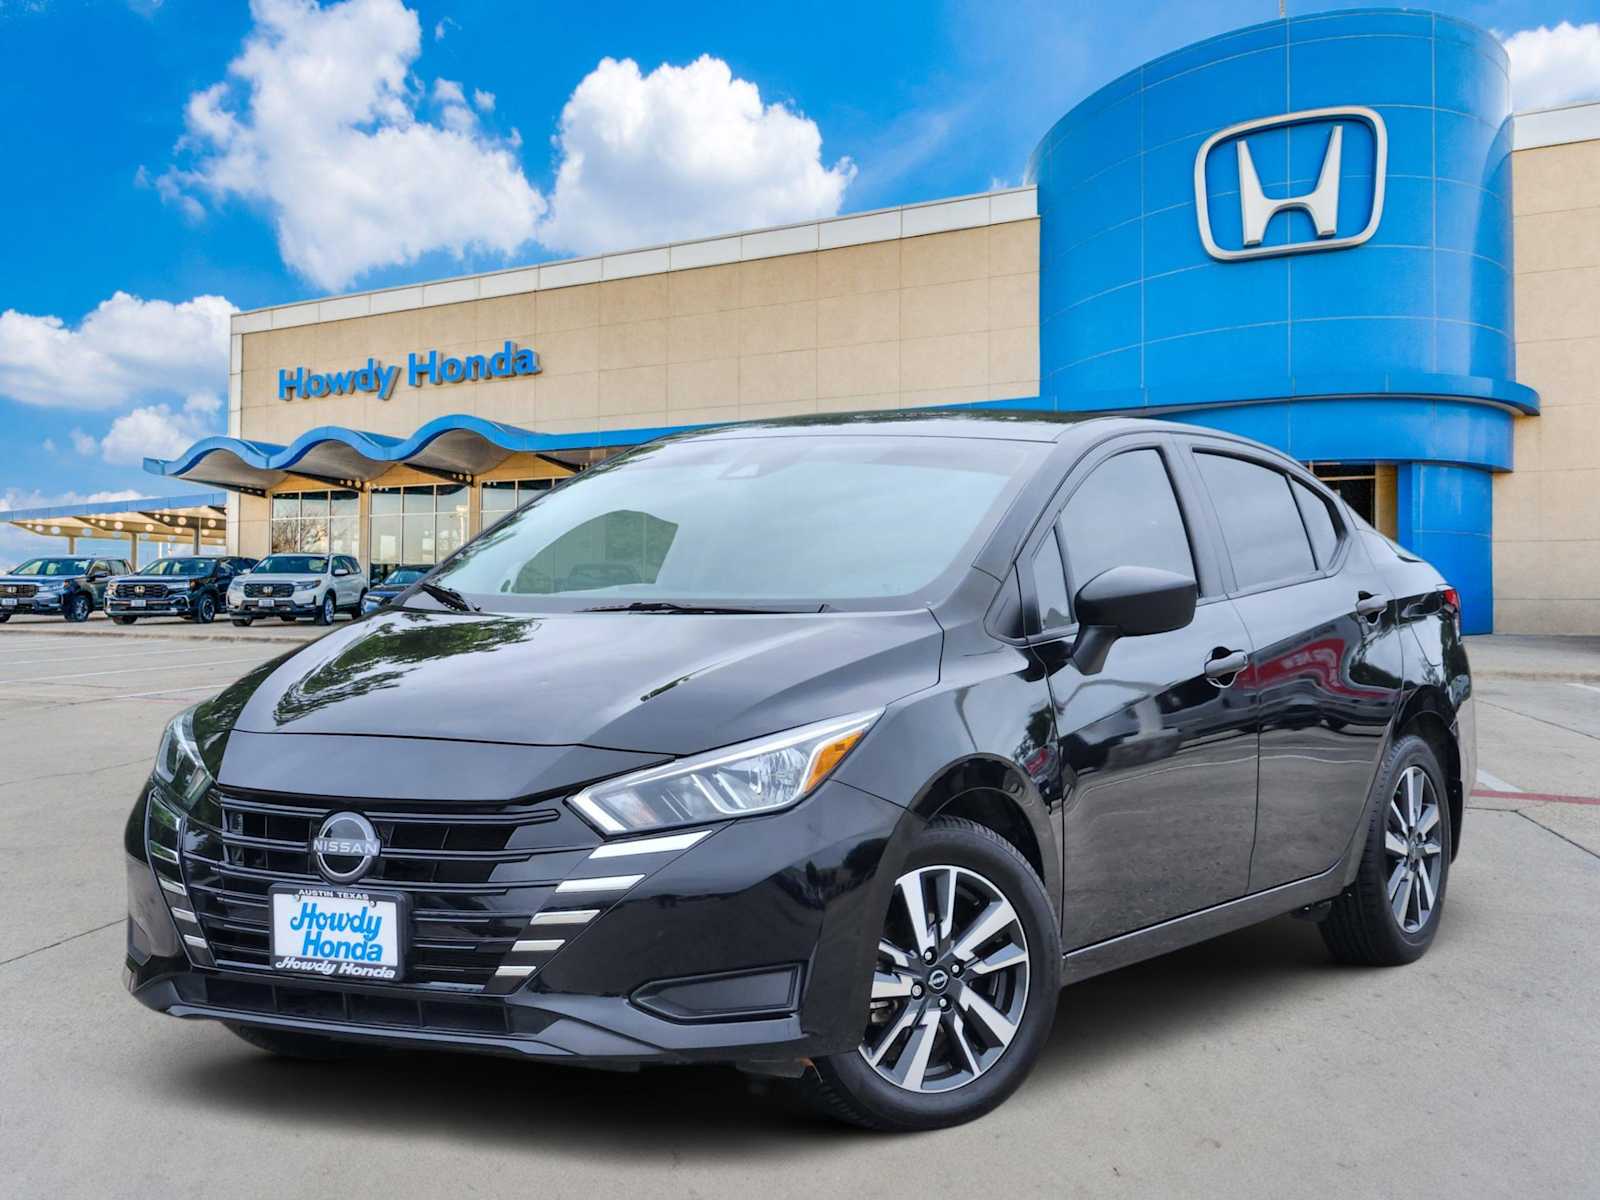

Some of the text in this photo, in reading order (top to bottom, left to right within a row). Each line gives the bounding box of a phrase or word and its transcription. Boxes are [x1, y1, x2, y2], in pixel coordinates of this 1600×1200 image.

[278, 340, 542, 401] Howdy Honda
[313, 839, 377, 854] NISSAN
[298, 889, 369, 900] AUSTIN TEXAS
[290, 902, 382, 942] Howdy
[302, 930, 384, 962] Honda
[275, 956, 396, 979] Howdy Honda
